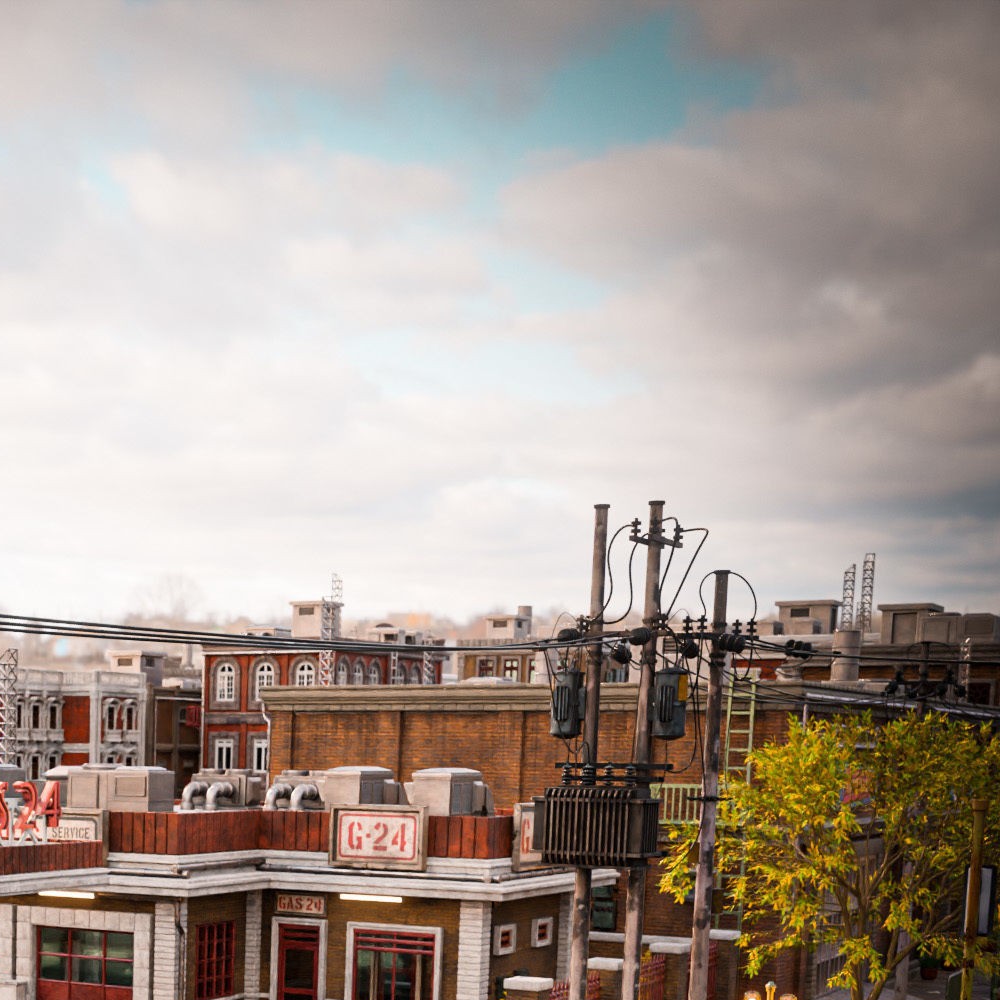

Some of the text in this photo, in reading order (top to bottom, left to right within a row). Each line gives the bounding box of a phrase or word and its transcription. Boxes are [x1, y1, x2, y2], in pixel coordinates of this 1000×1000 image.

[13, 780, 62, 832] 24
[52, 827, 90, 839] SERVICE
[279, 896, 322, 911] GAS 24
